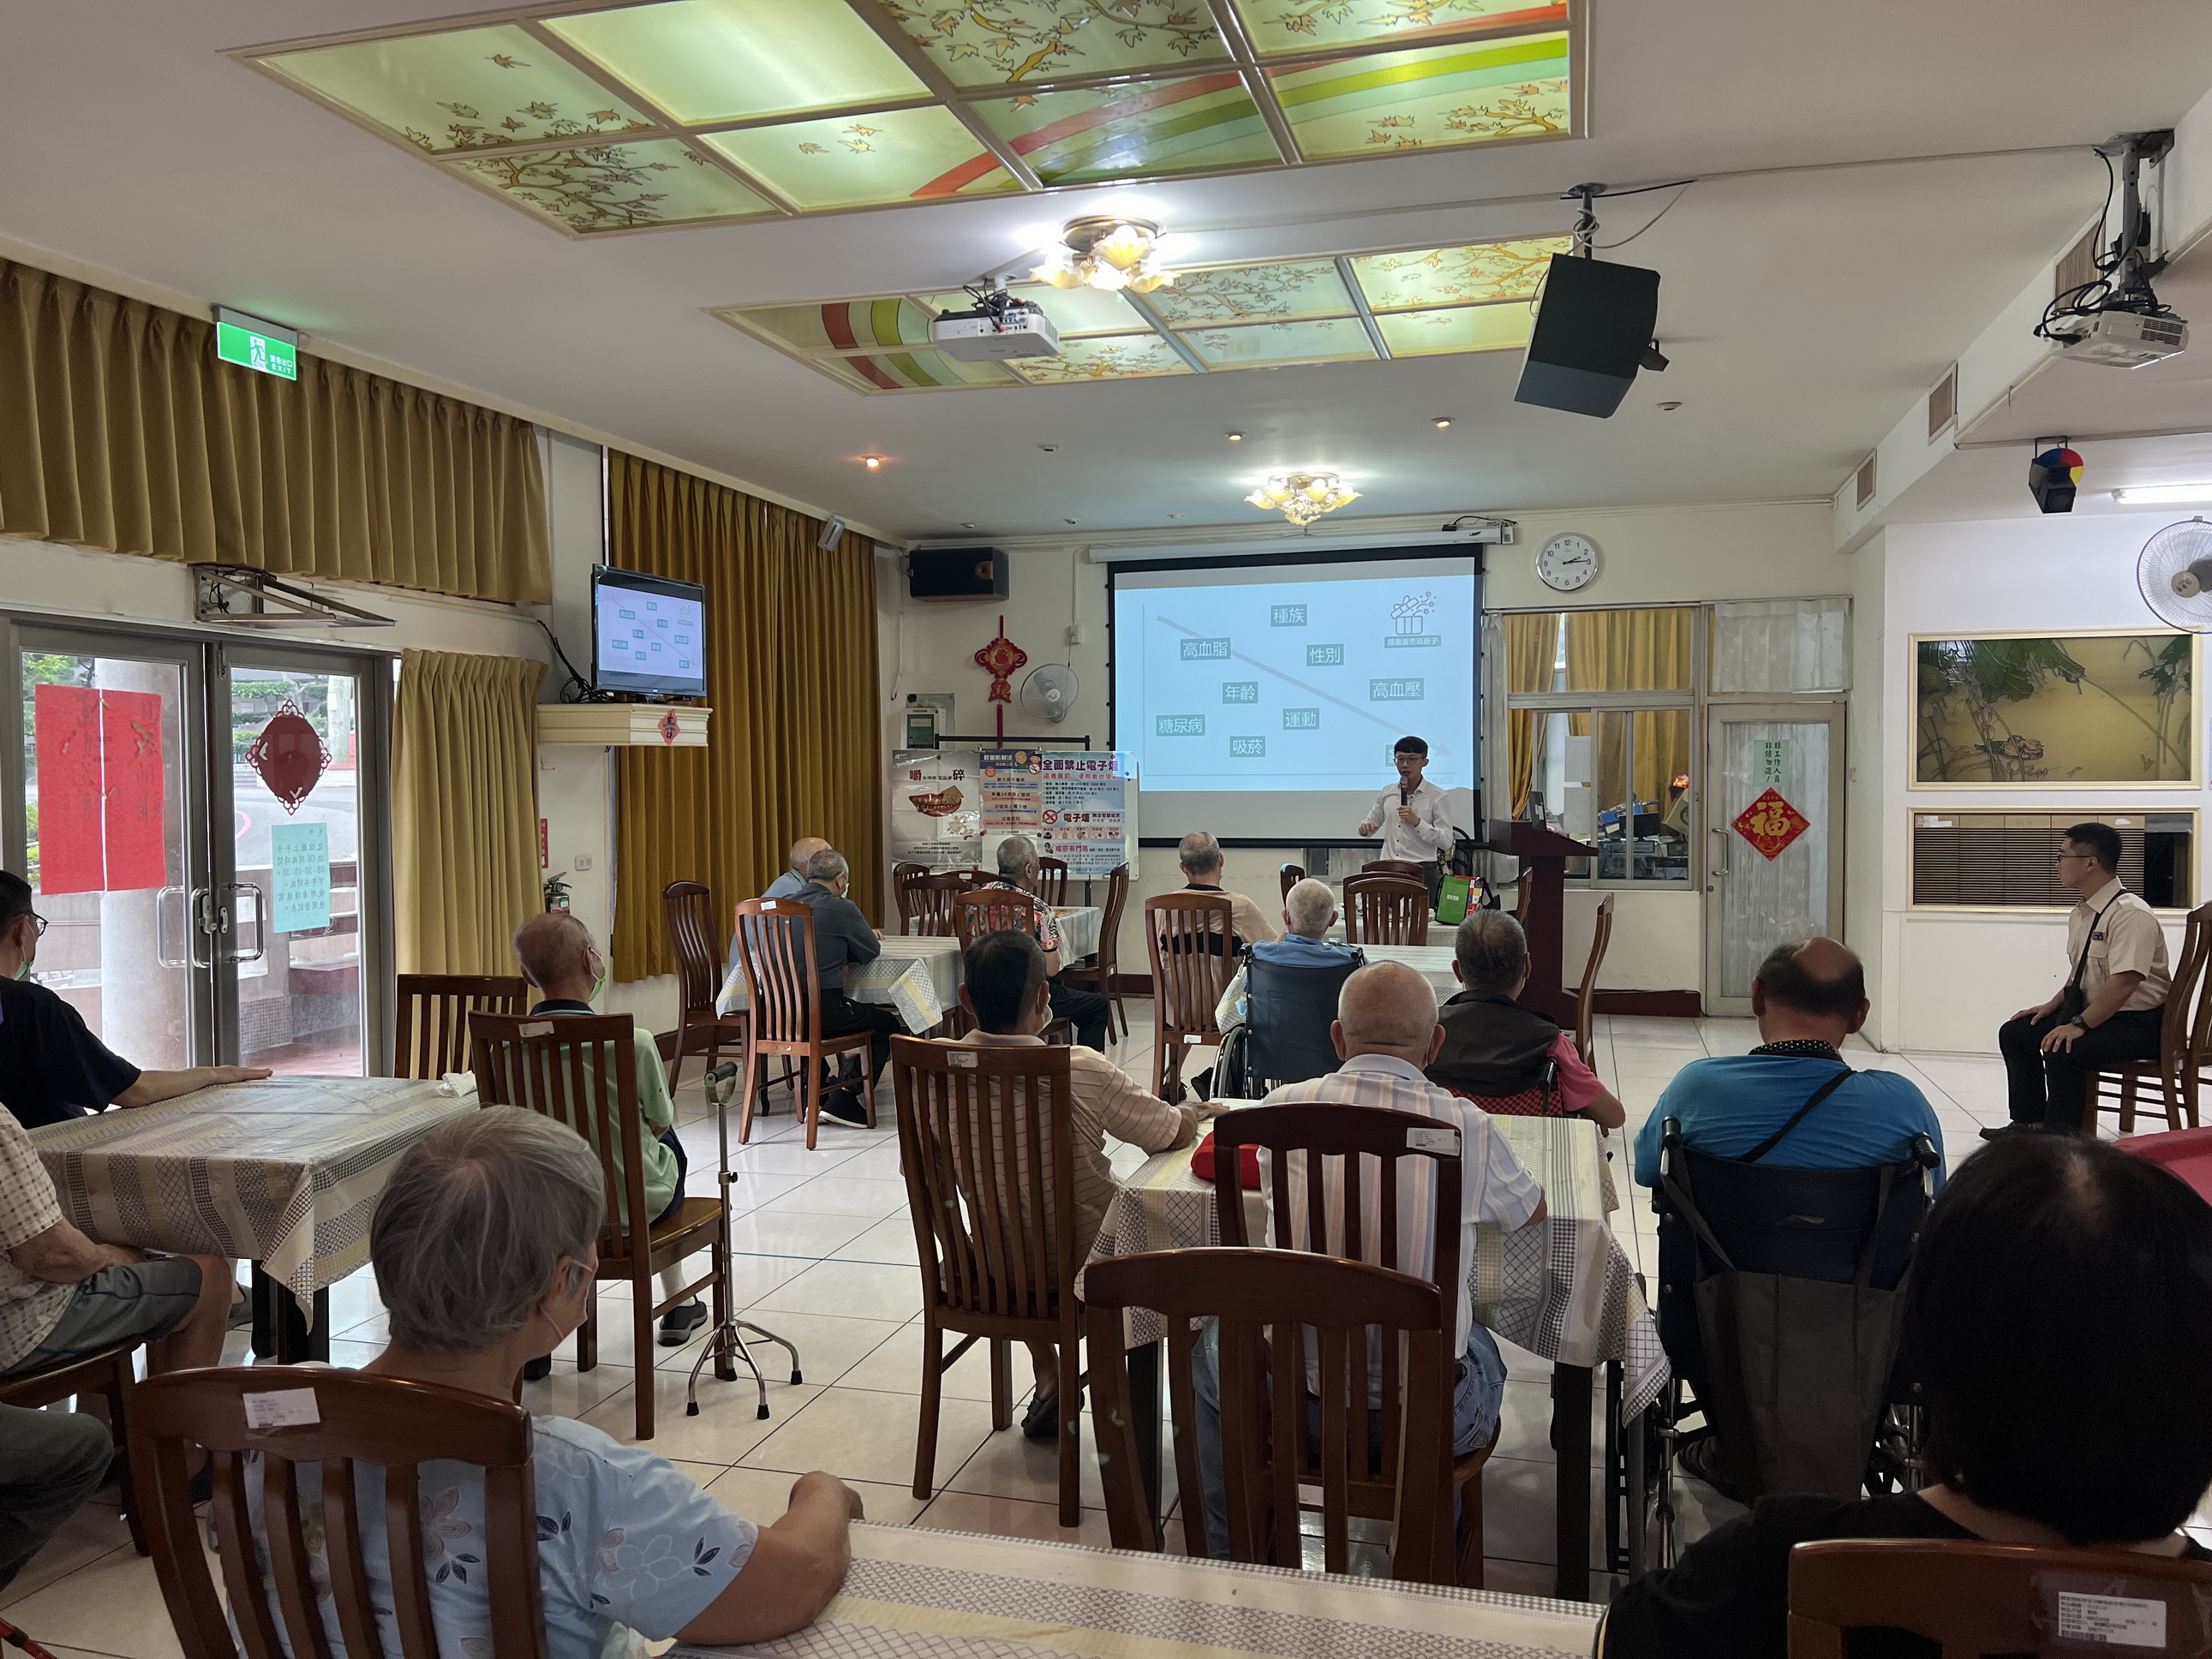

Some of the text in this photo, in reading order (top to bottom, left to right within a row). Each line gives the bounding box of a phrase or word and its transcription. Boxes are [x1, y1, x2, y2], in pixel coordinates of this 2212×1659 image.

[270, 355, 292, 368] 緊急出口
[272, 363, 292, 374] EXIT
[1273, 607, 1305, 624] 種族
[1183, 641, 1229, 658] 高血脂
[1310, 647, 1341, 664] 性別
[1225, 684, 1256, 701] 年齡
[1372, 681, 1421, 699] 高血壓
[1158, 718, 1204, 734] 糖尿病
[1285, 711, 1317, 727] 運動
[1233, 738, 1263, 755] 吸菸
[1043, 760, 1119, 771] 全面禁止電子煙
[1773, 742, 1782, 783] 非工作人員
[1063, 814, 1090, 822] 電子煙
[1749, 801, 1791, 837] 福
